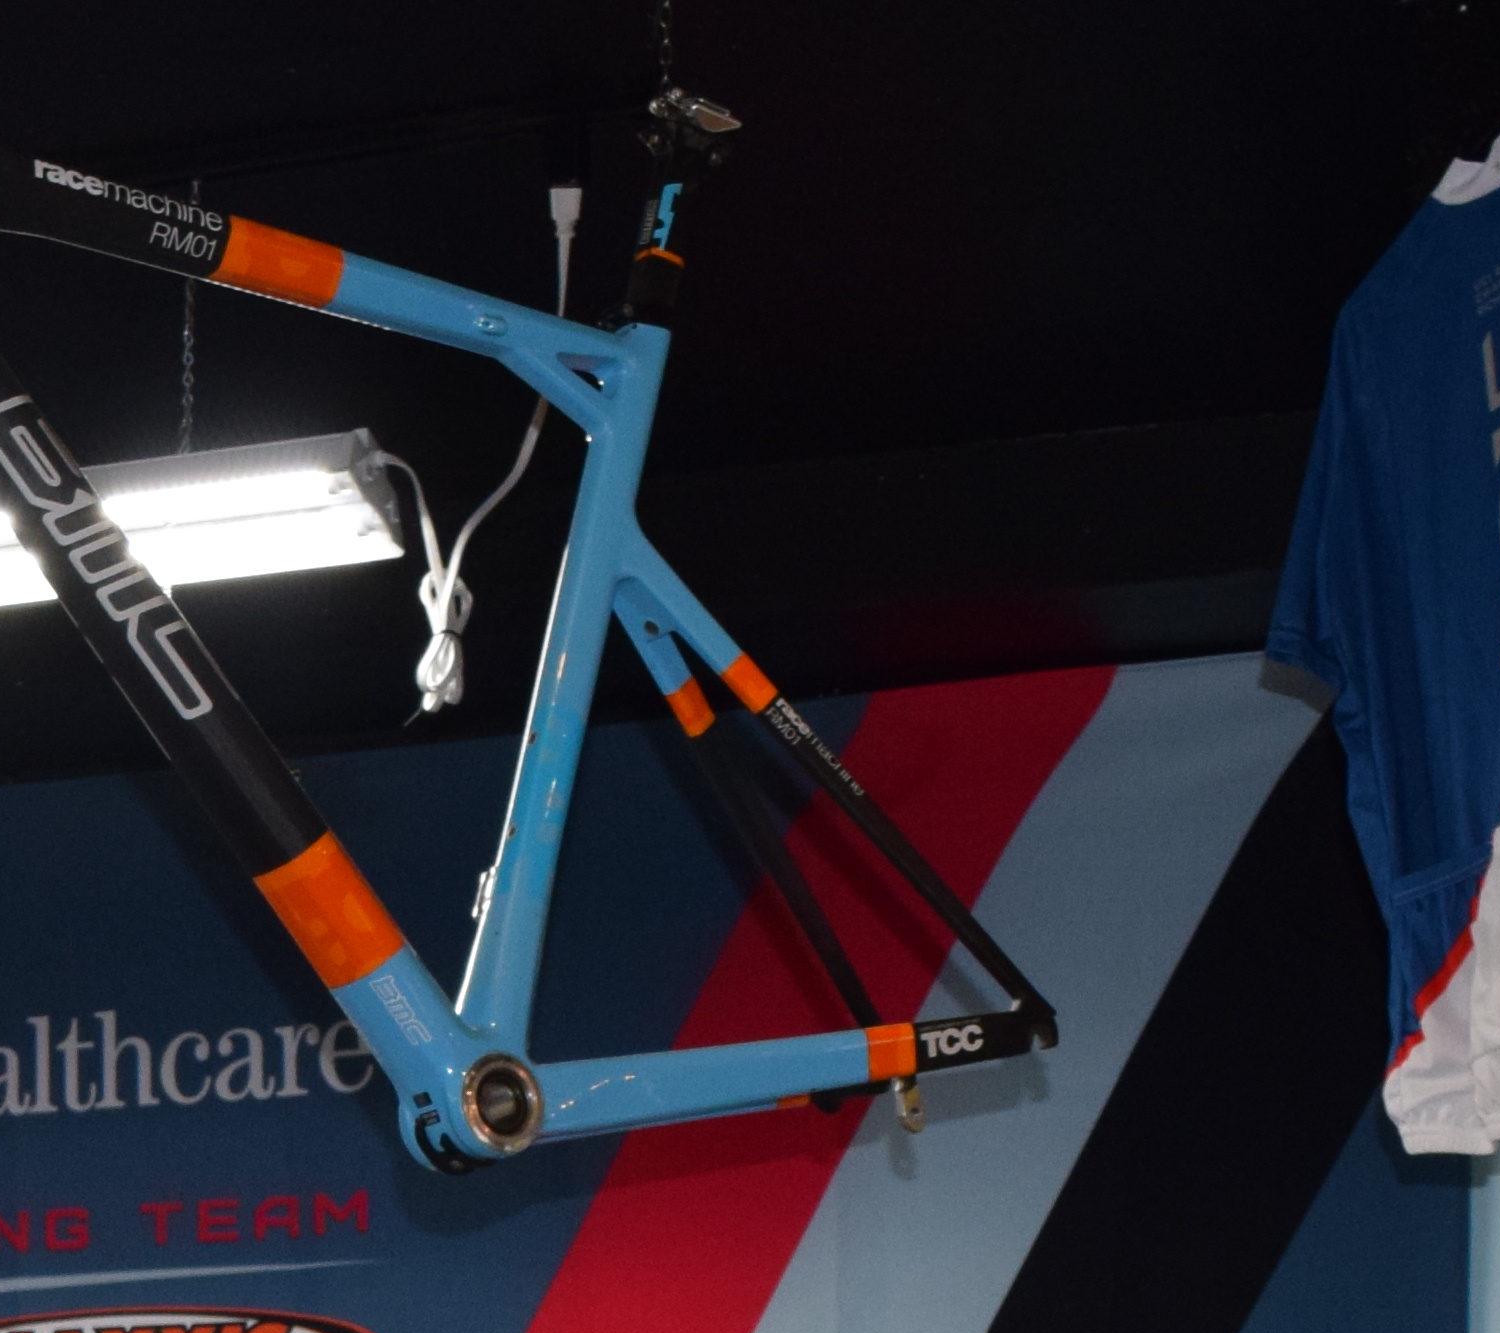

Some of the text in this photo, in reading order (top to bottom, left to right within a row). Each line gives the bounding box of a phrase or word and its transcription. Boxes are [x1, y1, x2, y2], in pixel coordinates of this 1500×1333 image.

[34, 157, 223, 233] racemachine
[149, 222, 219, 261] RM01
[920, 1024, 985, 1059] TCC
[140, 1189, 371, 1246] TEAM
